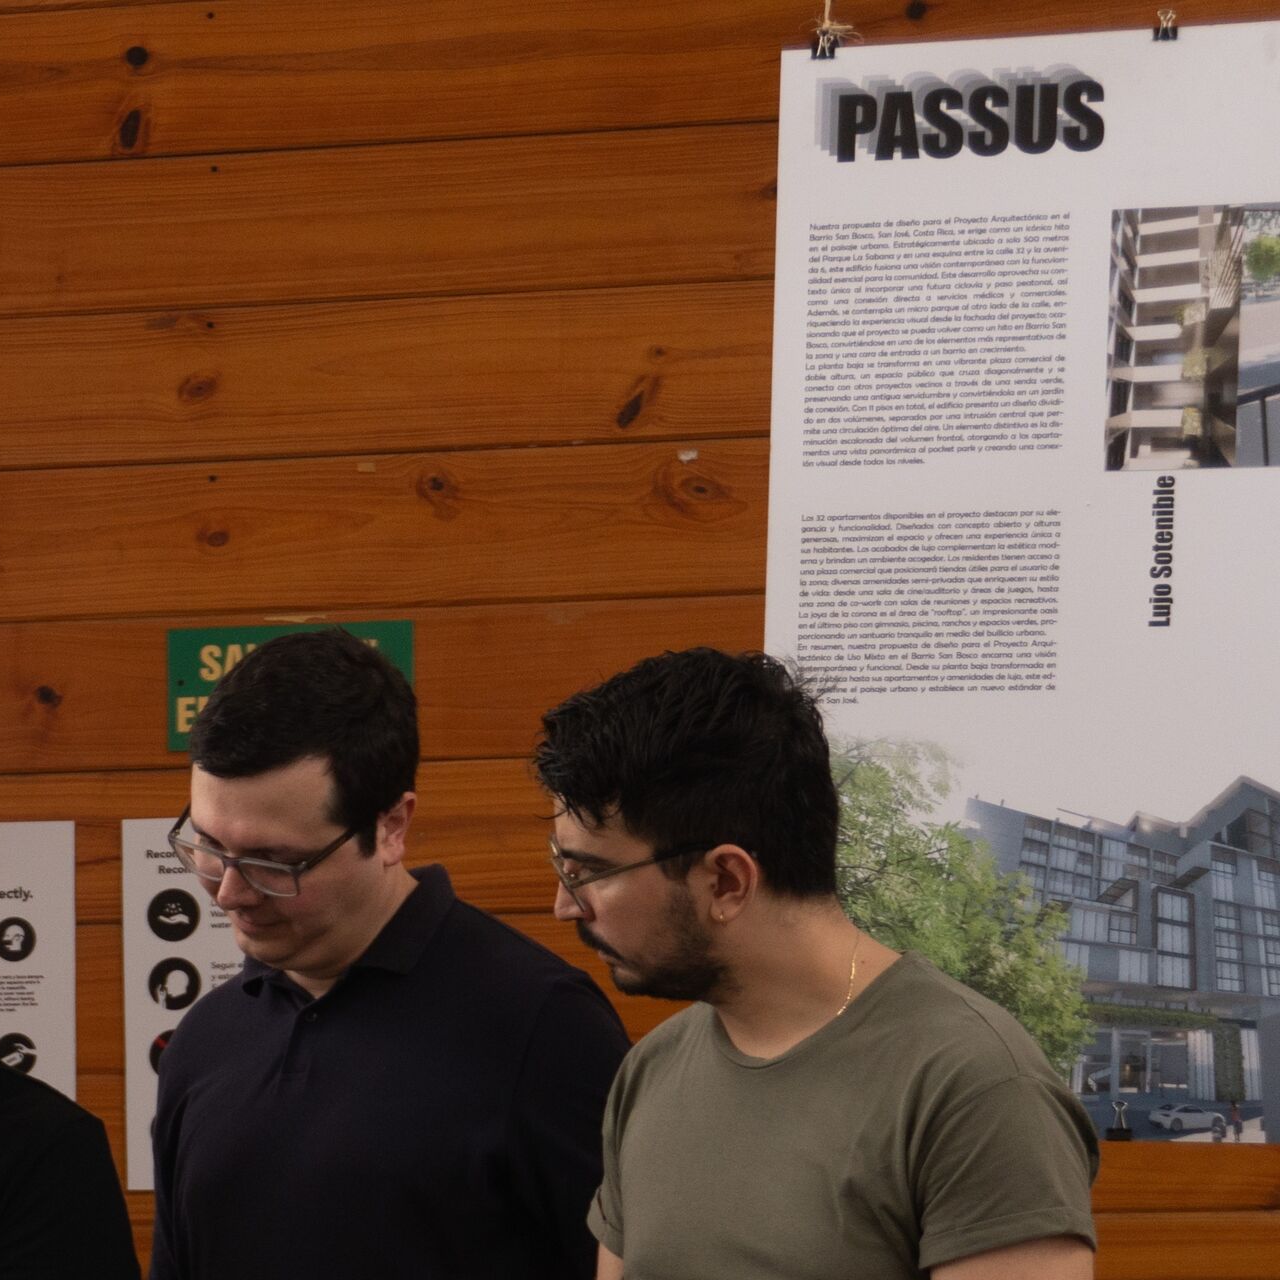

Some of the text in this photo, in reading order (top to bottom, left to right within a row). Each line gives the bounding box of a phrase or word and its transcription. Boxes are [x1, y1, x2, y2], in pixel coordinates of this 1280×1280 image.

[836, 78, 1105, 163] PASSUS
[809, 222, 840, 232] Nuestra
[883, 220, 894, 228] de
[895, 218, 921, 228] diseño
[922, 219, 942, 229] para
[944, 217, 952, 226] el
[1062, 211, 1070, 220] el
[809, 232, 834, 242] Barrio
[834, 232, 850, 241] San
[877, 230, 892, 239] San
[912, 228, 935, 237] Costa
[967, 226, 987, 237] erige
[1025, 223, 1052, 233] icónico
[1054, 222, 1070, 231] hito
[820, 244, 828, 252] el
[830, 242, 858, 254] paisaje
[962, 237, 995, 246] ubicado
[1006, 236, 1021, 244] solo
[1023, 235, 1040, 244] 500
[1042, 233, 1070, 243] metros
[807, 287, 828, 296] texto
[830, 286, 852, 295] único
[853, 285, 862, 294] al
[926, 281, 952, 291] futura
[986, 282, 992, 290] y
[994, 281, 1014, 290] paso
[1056, 277, 1068, 285] así
[893, 294, 920, 303] directa
[972, 290, 1005, 300] médicos
[1009, 292, 1015, 300] y
[805, 362, 816, 371] La
[818, 361, 844, 372] planta
[846, 360, 864, 371] baja
[989, 356, 1012, 367] plaza
[1054, 354, 1066, 362] de
[804, 373, 827, 382] doble
[874, 370, 903, 381] espacio
[906, 369, 936, 380] público
[938, 370, 955, 379] que
[1047, 367, 1053, 376] y
[800, 525, 827, 536] gancia
[829, 526, 835, 535] y
[992, 520, 1022, 529] abierto
[1024, 522, 1031, 530] y
[1033, 519, 1061, 528] alturas
[886, 533, 894, 542] el
[896, 533, 925, 544] espacio
[926, 535, 933, 543] y
[934, 532, 964, 541] ofrecen
[1030, 530, 1053, 539] única
[1147, 475, 1176, 627] Lujo Sotenible
[837, 599, 848, 608] de
[849, 599, 882, 608] co-work
[900, 598, 919, 607] salas
[920, 598, 932, 606] de
[972, 599, 978, 607] y
